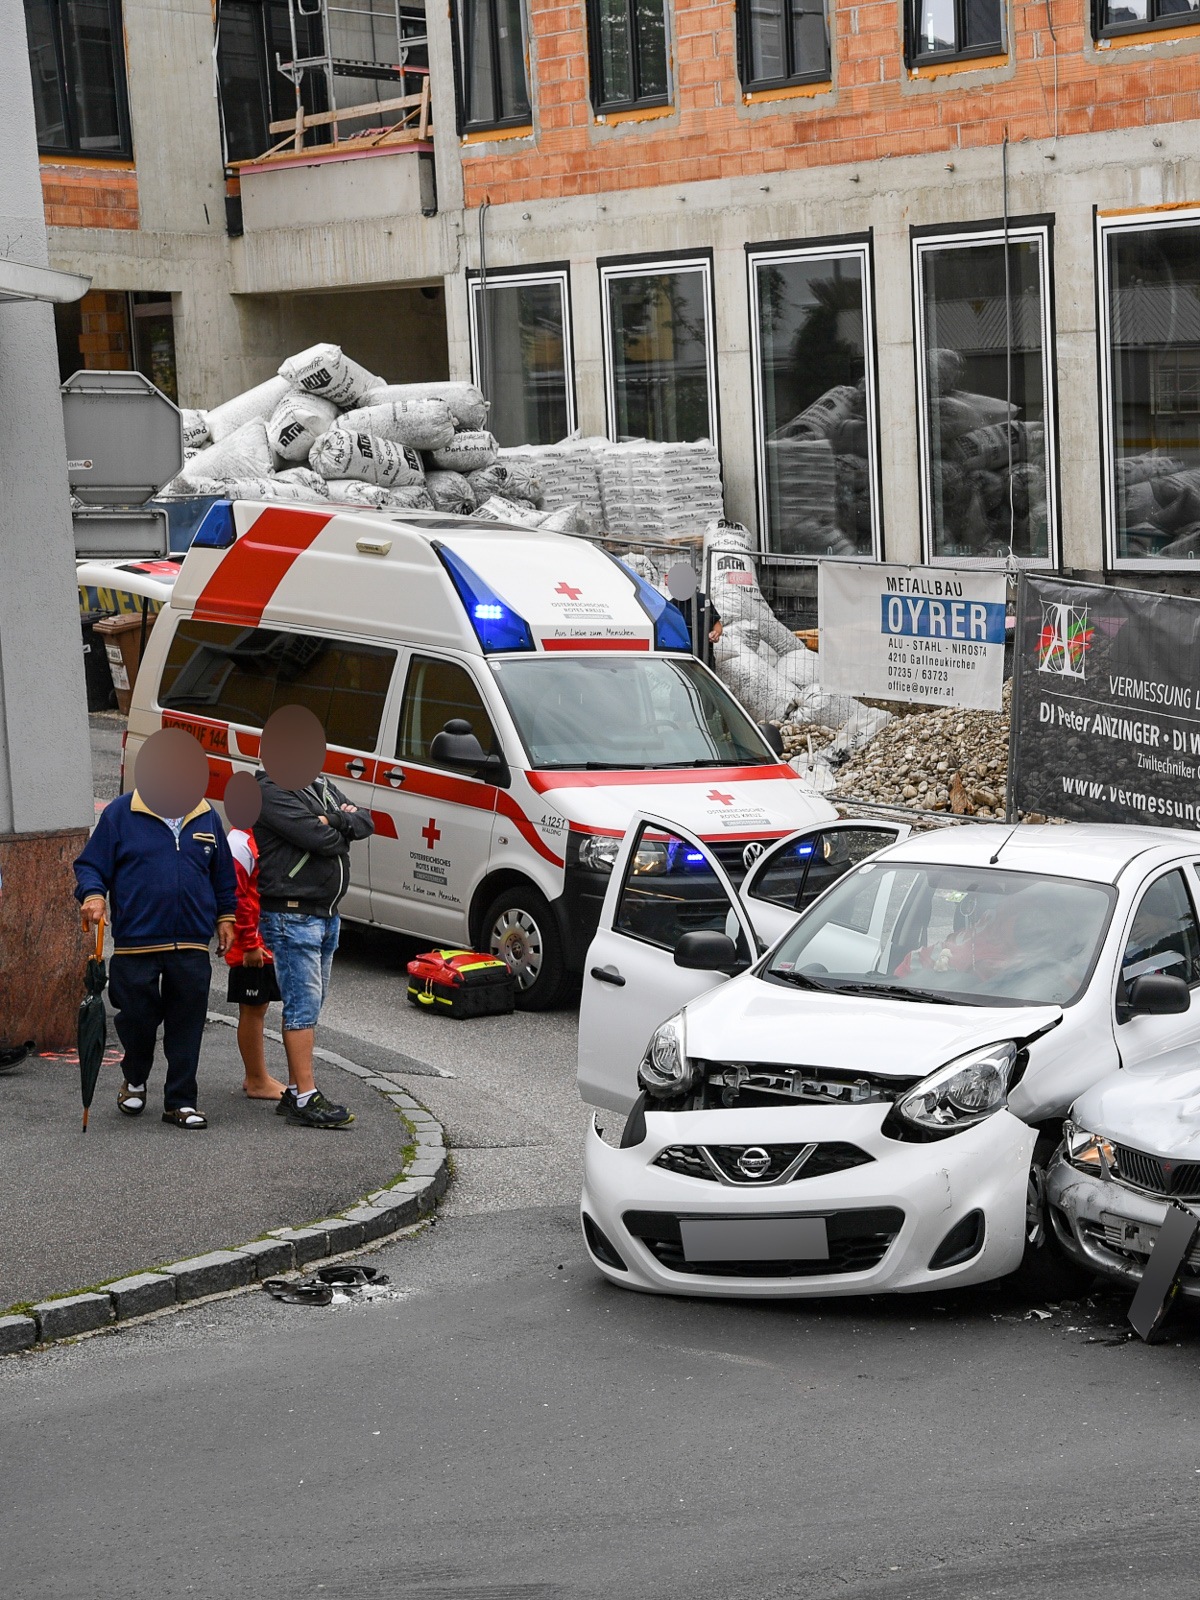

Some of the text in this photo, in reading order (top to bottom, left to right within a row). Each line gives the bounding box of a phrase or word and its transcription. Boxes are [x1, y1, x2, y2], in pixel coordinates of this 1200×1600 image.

[886, 576, 963, 597] METALLBAU
[888, 597, 987, 640] OYRER
[555, 629, 567, 637] Aus
[570, 628, 587, 636] Liebe
[888, 638, 903, 649] ALU
[912, 640, 942, 653] STAHL
[951, 643, 987, 657] NIROSTA
[888, 652, 976, 670] 4210 Gallneukirchen
[888, 666, 912, 678] 07235
[921, 669, 948, 681] 63723
[888, 681, 955, 696] office@oyrer.at
[1109, 675, 1191, 709] VERMESSUNG
[1039, 702, 1055, 724] DI
[1057, 706, 1091, 732] Peter
[1091, 714, 1160, 747] ANZINGER
[1172, 729, 1187, 753] DI
[209, 729, 228, 748] 144
[1137, 753, 1195, 779] Ziviltechniker
[540, 814, 566, 829] 4.1251
[541, 827, 562, 836] WALDING
[409, 851, 451, 867] ÖSTERREICHISCHES
[416, 862, 429, 872] ROTES
[402, 881, 411, 891] Aus
[413, 884, 425, 894] Liebe
